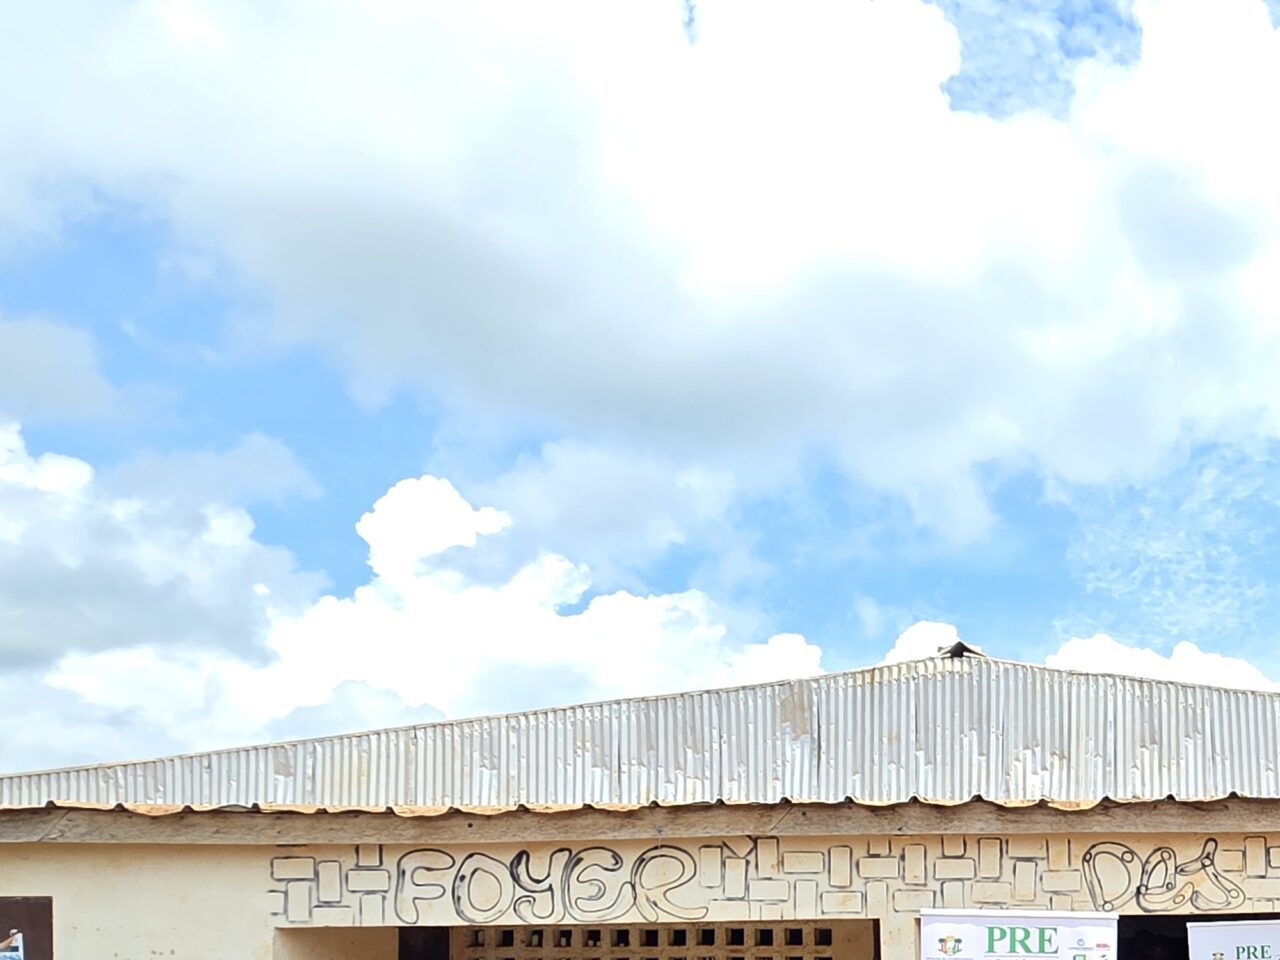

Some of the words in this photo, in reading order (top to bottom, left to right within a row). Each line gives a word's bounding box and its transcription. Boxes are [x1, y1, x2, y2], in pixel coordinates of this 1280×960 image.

[395, 845, 708, 924] FOYER
[984, 926, 1059, 954] PRE
[1235, 945, 1272, 960] PRE
